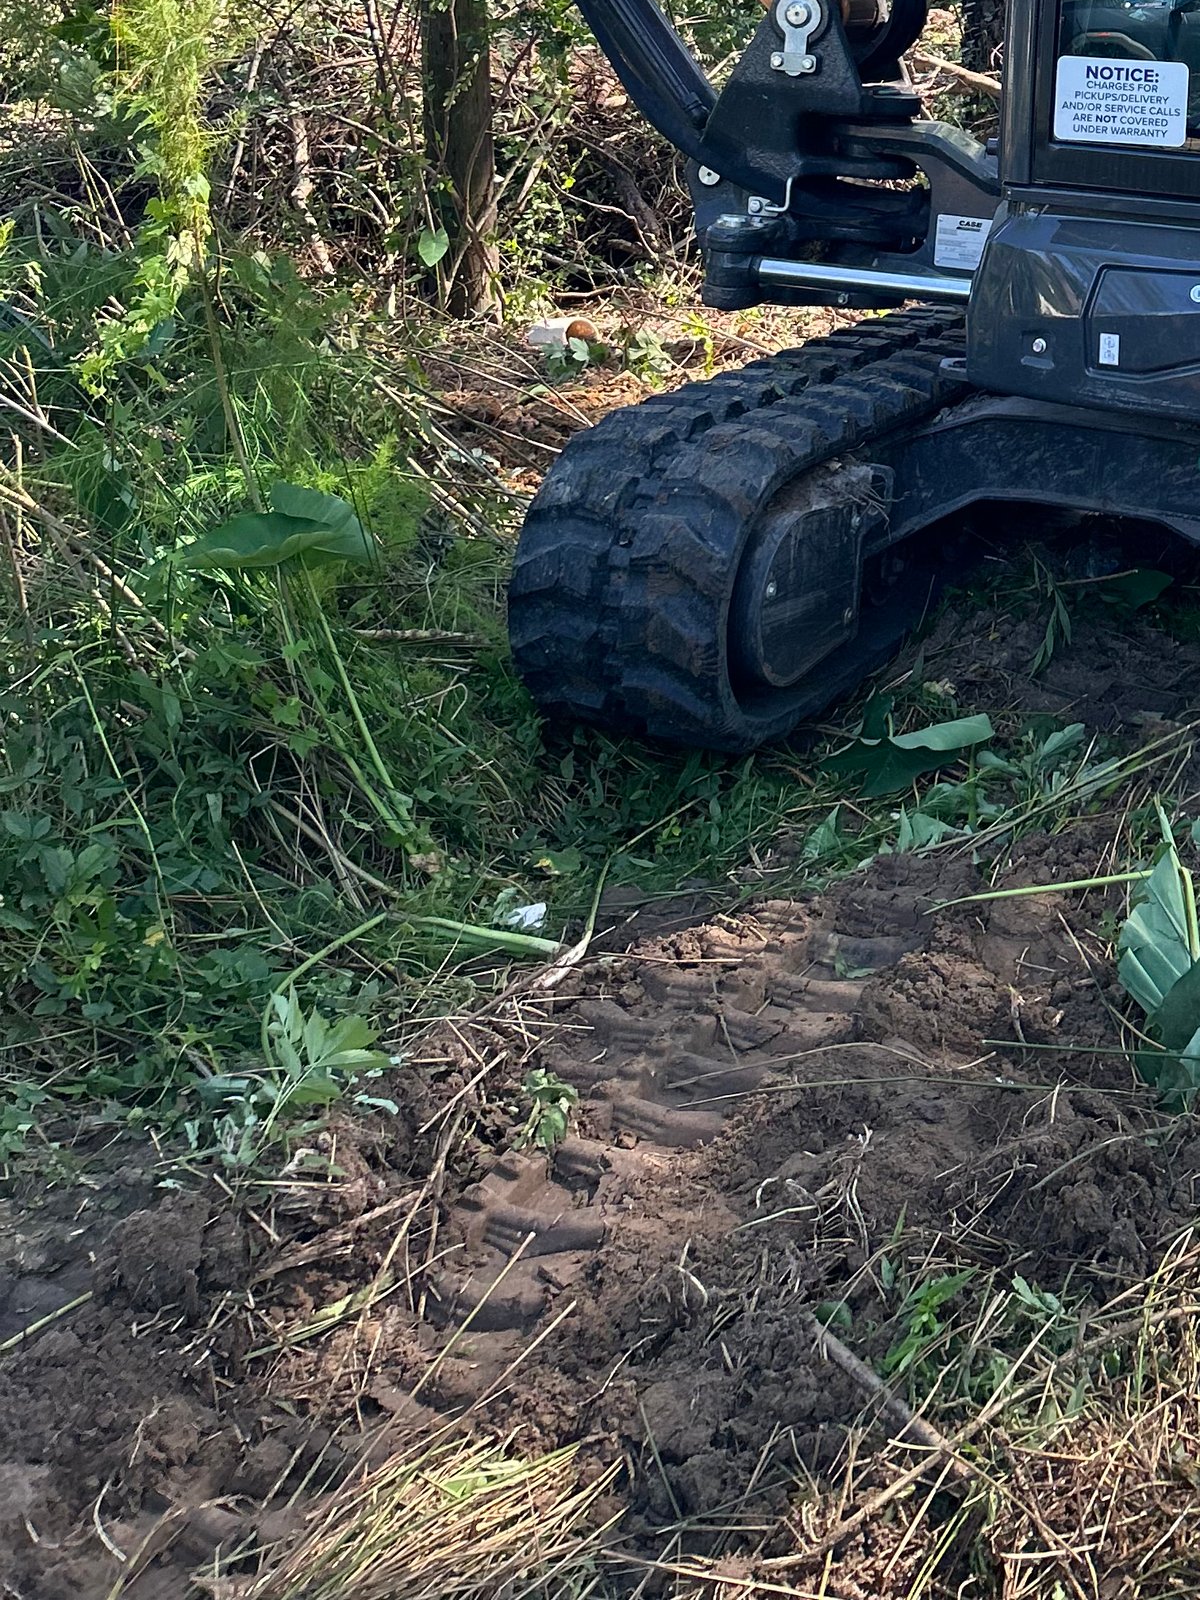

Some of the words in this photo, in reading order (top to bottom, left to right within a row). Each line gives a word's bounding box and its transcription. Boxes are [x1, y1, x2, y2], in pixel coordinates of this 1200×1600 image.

[1086, 65, 1160, 84] NOTICE:
[1086, 80, 1135, 92] CHARGES
[1137, 83, 1159, 93] FOR
[1074, 90, 1170, 105] PICKUPS/DELIVERY
[1061, 100, 1102, 112] AND/OR
[1104, 103, 1147, 115] SERVICE
[1148, 106, 1181, 117] CALLS
[1072, 112, 1093, 122] ARE
[1095, 114, 1118, 124] NOT
[1119, 115, 1169, 127] COVERED
[1072, 124, 1108, 135] UNDER
[1110, 126, 1169, 138] WARRANTY
[958, 220, 983, 229] CASE
